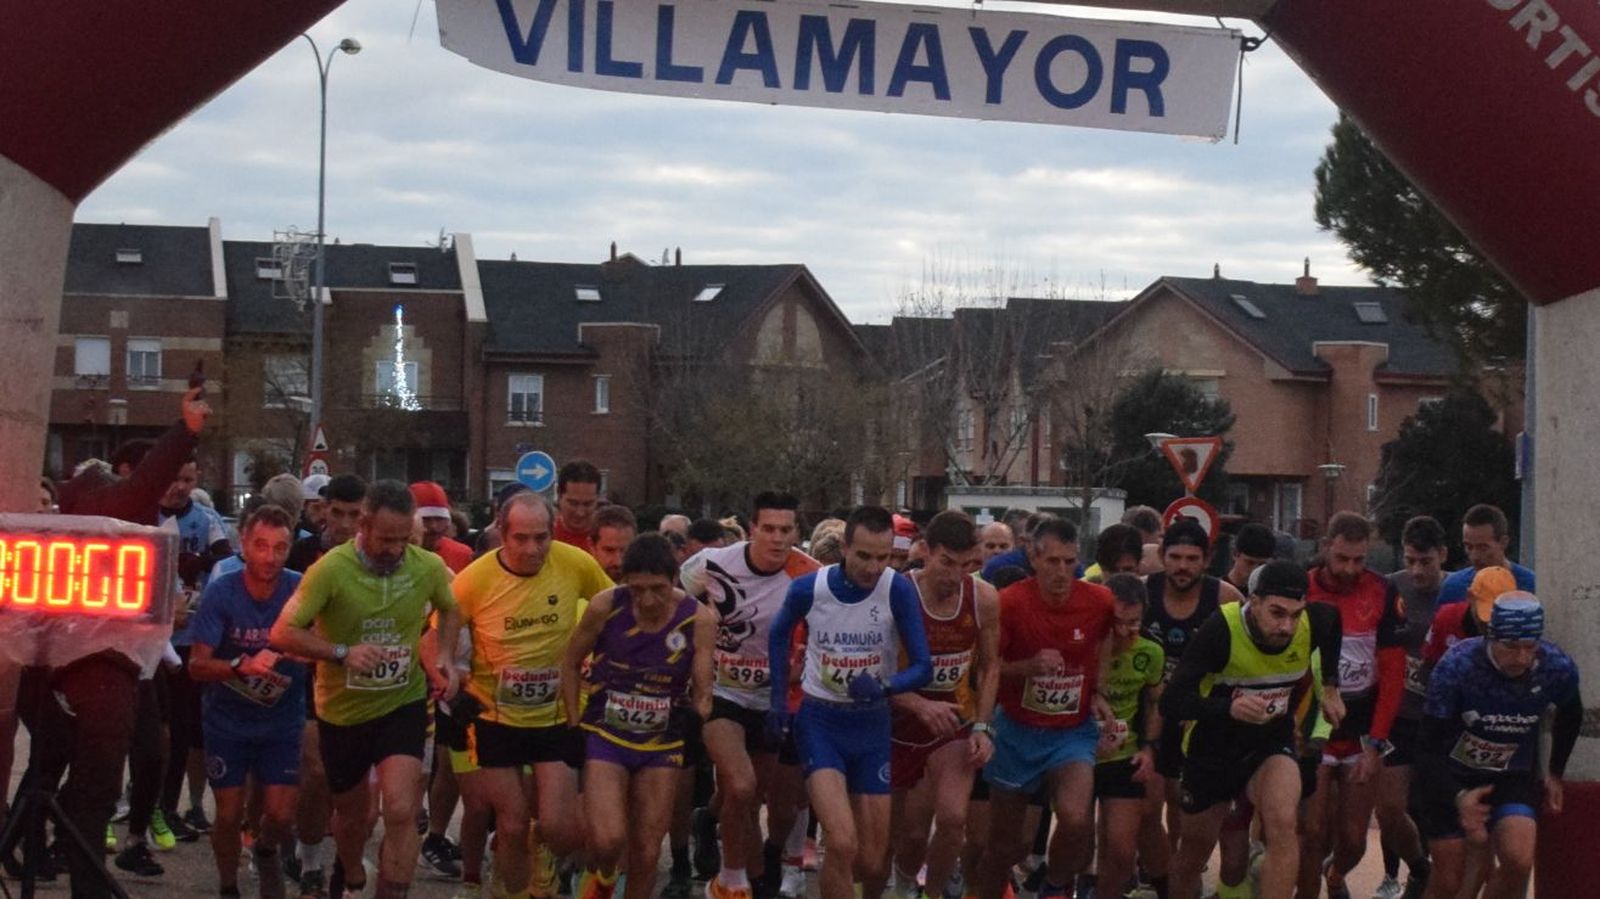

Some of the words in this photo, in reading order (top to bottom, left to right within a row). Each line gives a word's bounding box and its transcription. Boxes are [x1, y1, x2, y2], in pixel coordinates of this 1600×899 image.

[496, 0, 1170, 117] VILLAMAYOR
[1488, 0, 1600, 117] RTI
[817, 631, 830, 644] LA
[833, 630, 884, 645] ARMUÑA
[729, 666, 763, 683] 398
[831, 668, 869, 685] 46
[512, 682, 549, 698] 353
[1036, 689, 1071, 705] 346
[618, 708, 656, 725] 342
